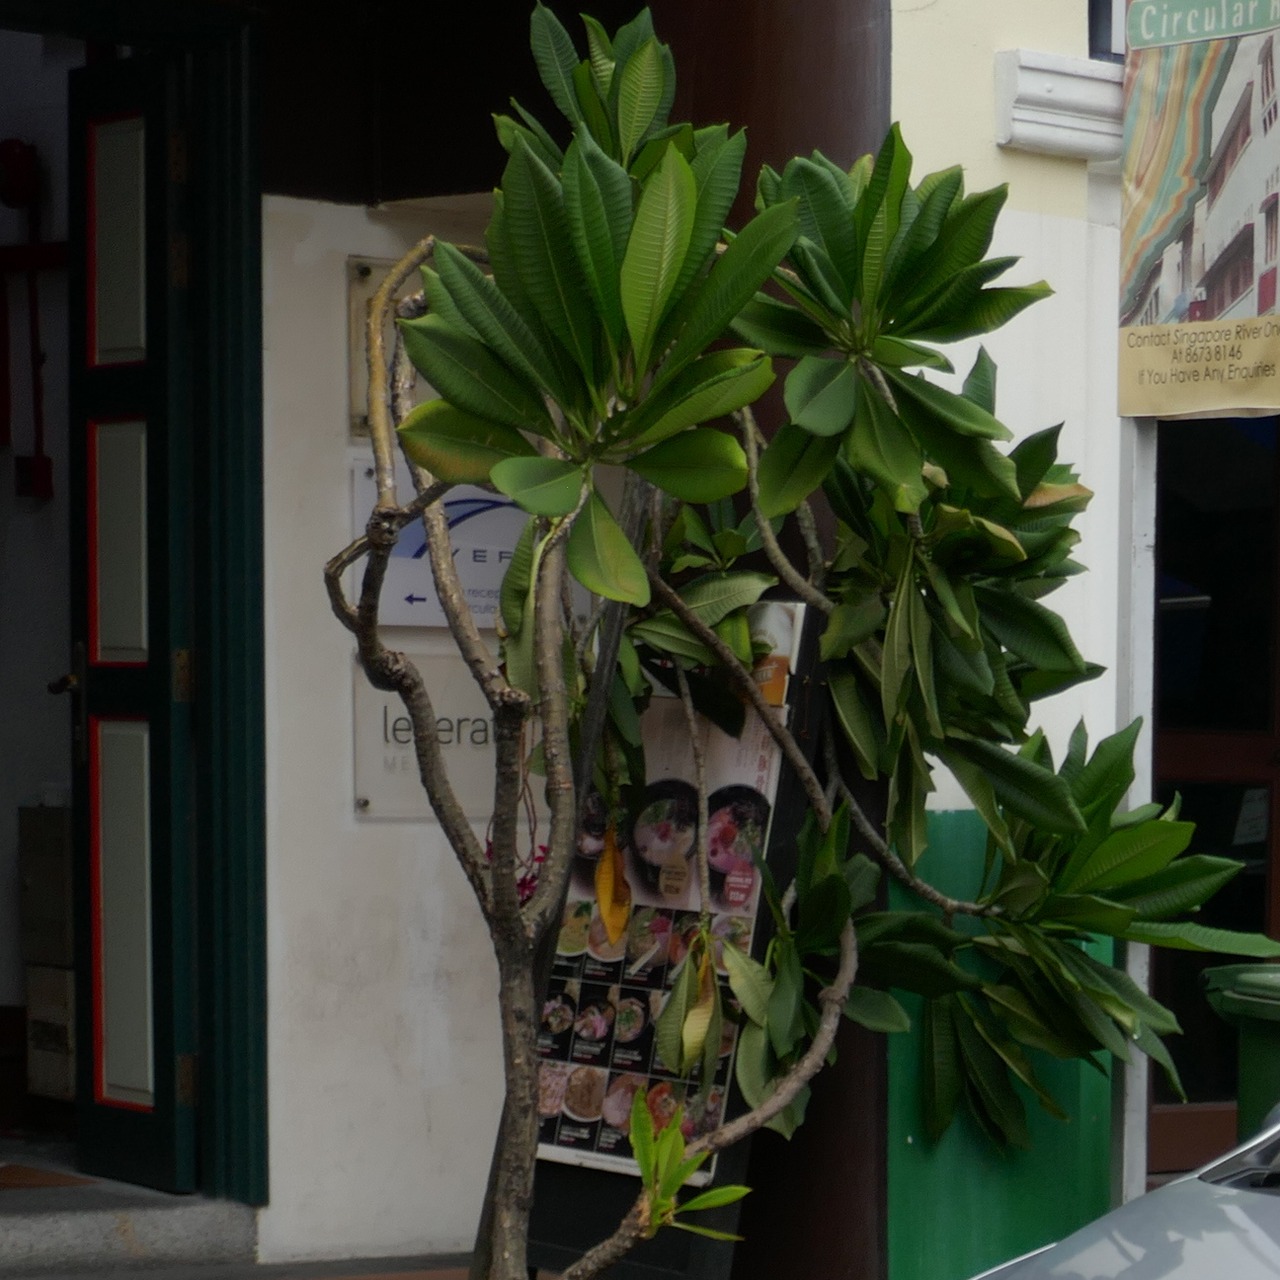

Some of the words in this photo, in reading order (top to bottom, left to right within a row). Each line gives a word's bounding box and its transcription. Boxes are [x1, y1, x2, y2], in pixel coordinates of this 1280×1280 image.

[1140, 0, 1258, 40] Circular
[1127, 332, 1170, 349] Contact
[1174, 329, 1231, 348] Singapore
[1235, 324, 1262, 341] River
[1171, 350, 1183, 364] At
[1185, 347, 1212, 364] 8673
[1214, 345, 1243, 362] 8146
[1138, 370, 1144, 385] If
[1147, 370, 1167, 385] You
[1170, 368, 1200, 384] Have
[1204, 366, 1225, 384] Any
[1227, 363, 1276, 381] Enquiries
